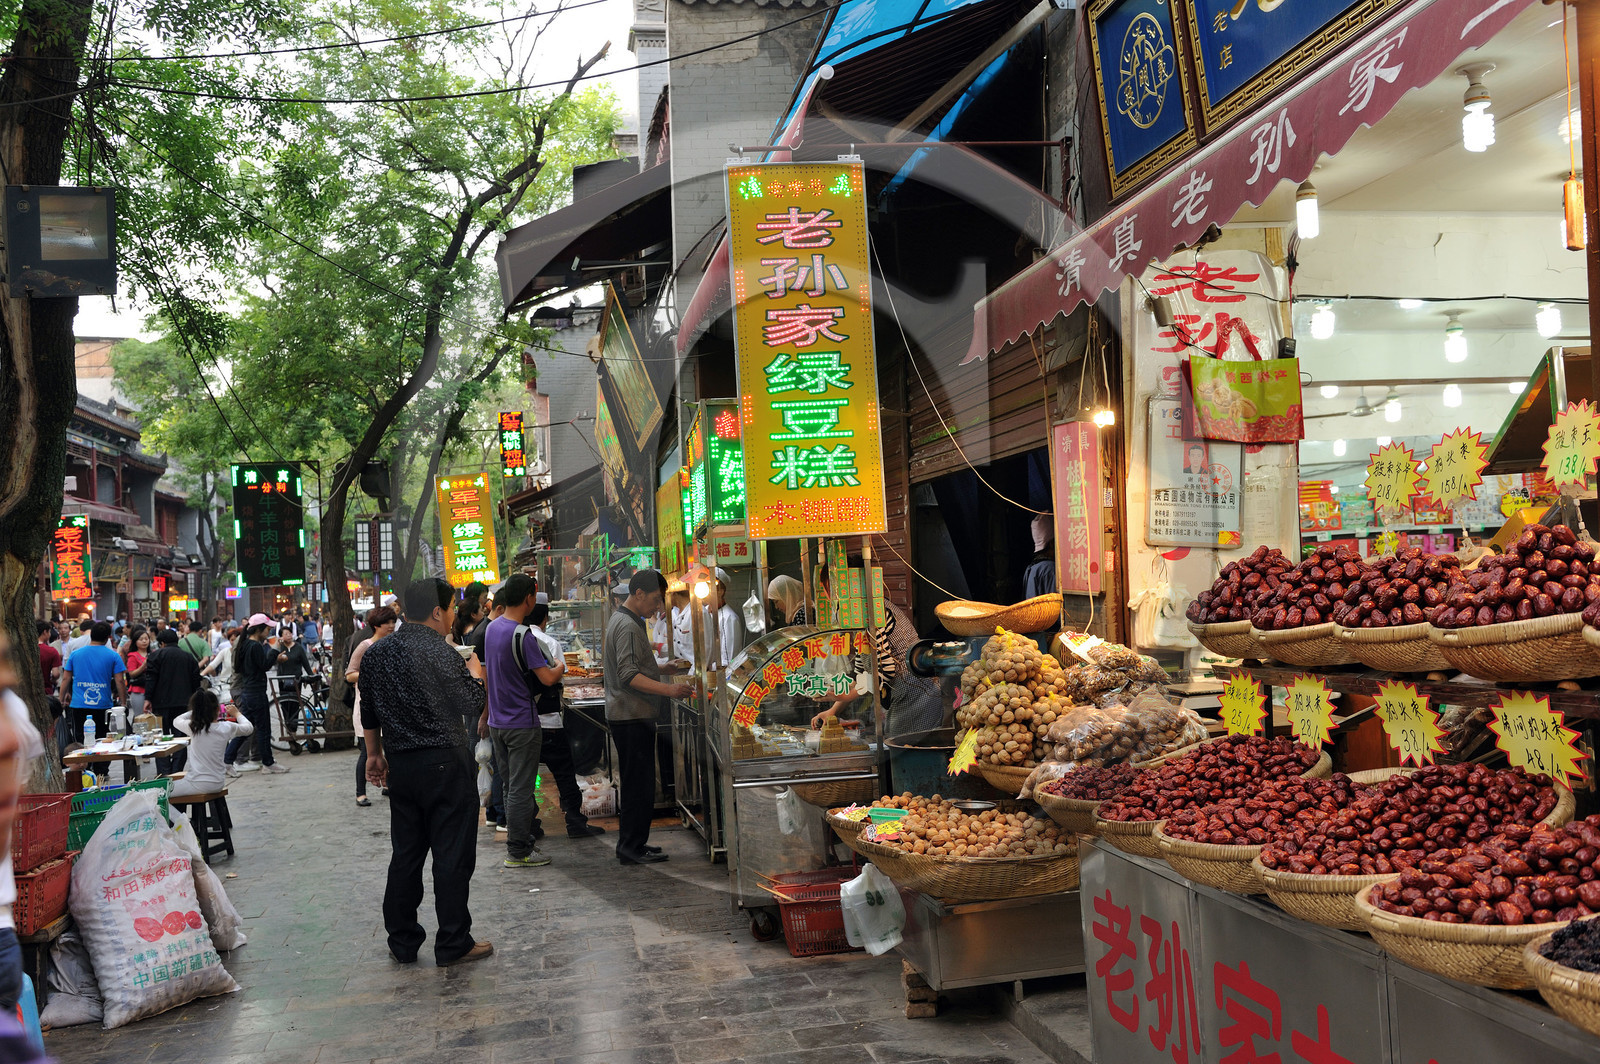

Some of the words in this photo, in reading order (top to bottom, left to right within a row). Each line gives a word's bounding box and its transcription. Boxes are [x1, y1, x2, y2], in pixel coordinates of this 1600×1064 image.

[1211, 8, 1234, 71] 老店
[755, 206, 862, 491] 老孙家绿豆糕
[258, 494, 282, 579] 牛羊肉泡馍
[448, 489, 489, 572] 军军绿豆糕
[762, 496, 872, 525] 木糖醇
